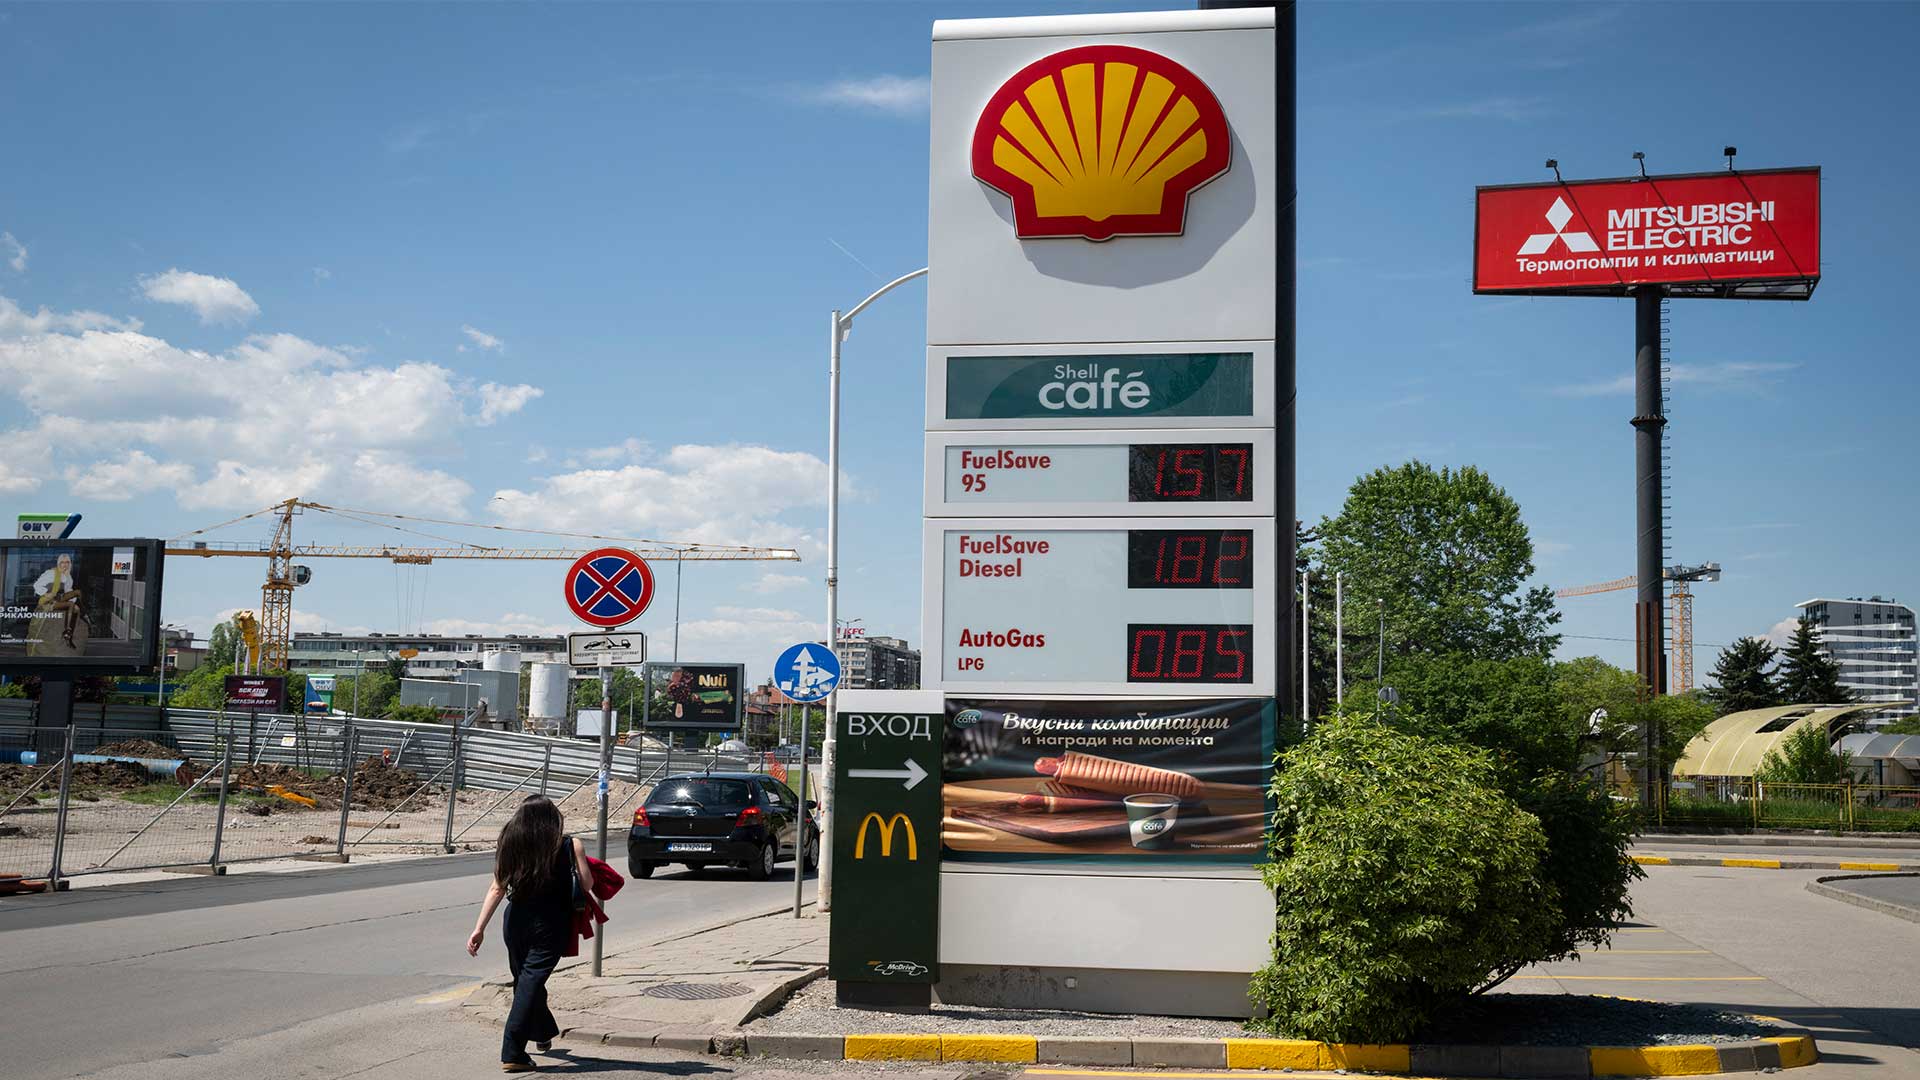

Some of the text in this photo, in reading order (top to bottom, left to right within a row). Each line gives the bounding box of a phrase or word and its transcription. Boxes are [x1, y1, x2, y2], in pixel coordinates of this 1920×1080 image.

[1608, 201, 1775, 230] MITSUBISHI
[1608, 224, 1752, 251] ELECTRIC
[1516, 250, 1775, 275] Термопомпи и климатици
[1054, 364, 1098, 379] Shell
[1038, 368, 1150, 410] café
[961, 451, 1051, 470] FuelSave
[1154, 449, 1248, 496] 1.57
[961, 474, 986, 492] 95
[959, 535, 1050, 554] FuelSave
[959, 559, 1022, 577] Diesel
[1155, 536, 1248, 583] 1.82
[959, 629, 1046, 648] AutoGas
[1130, 630, 1248, 679] 0.85
[958, 658, 985, 671] LPG
[698, 673, 728, 688] Nuii
[848, 714, 932, 741] ВХОД
[1002, 711, 1231, 736] Вкусни комбинации
[1021, 736, 1215, 748] и награди на момента
[887, 963, 917, 971] McDrive
